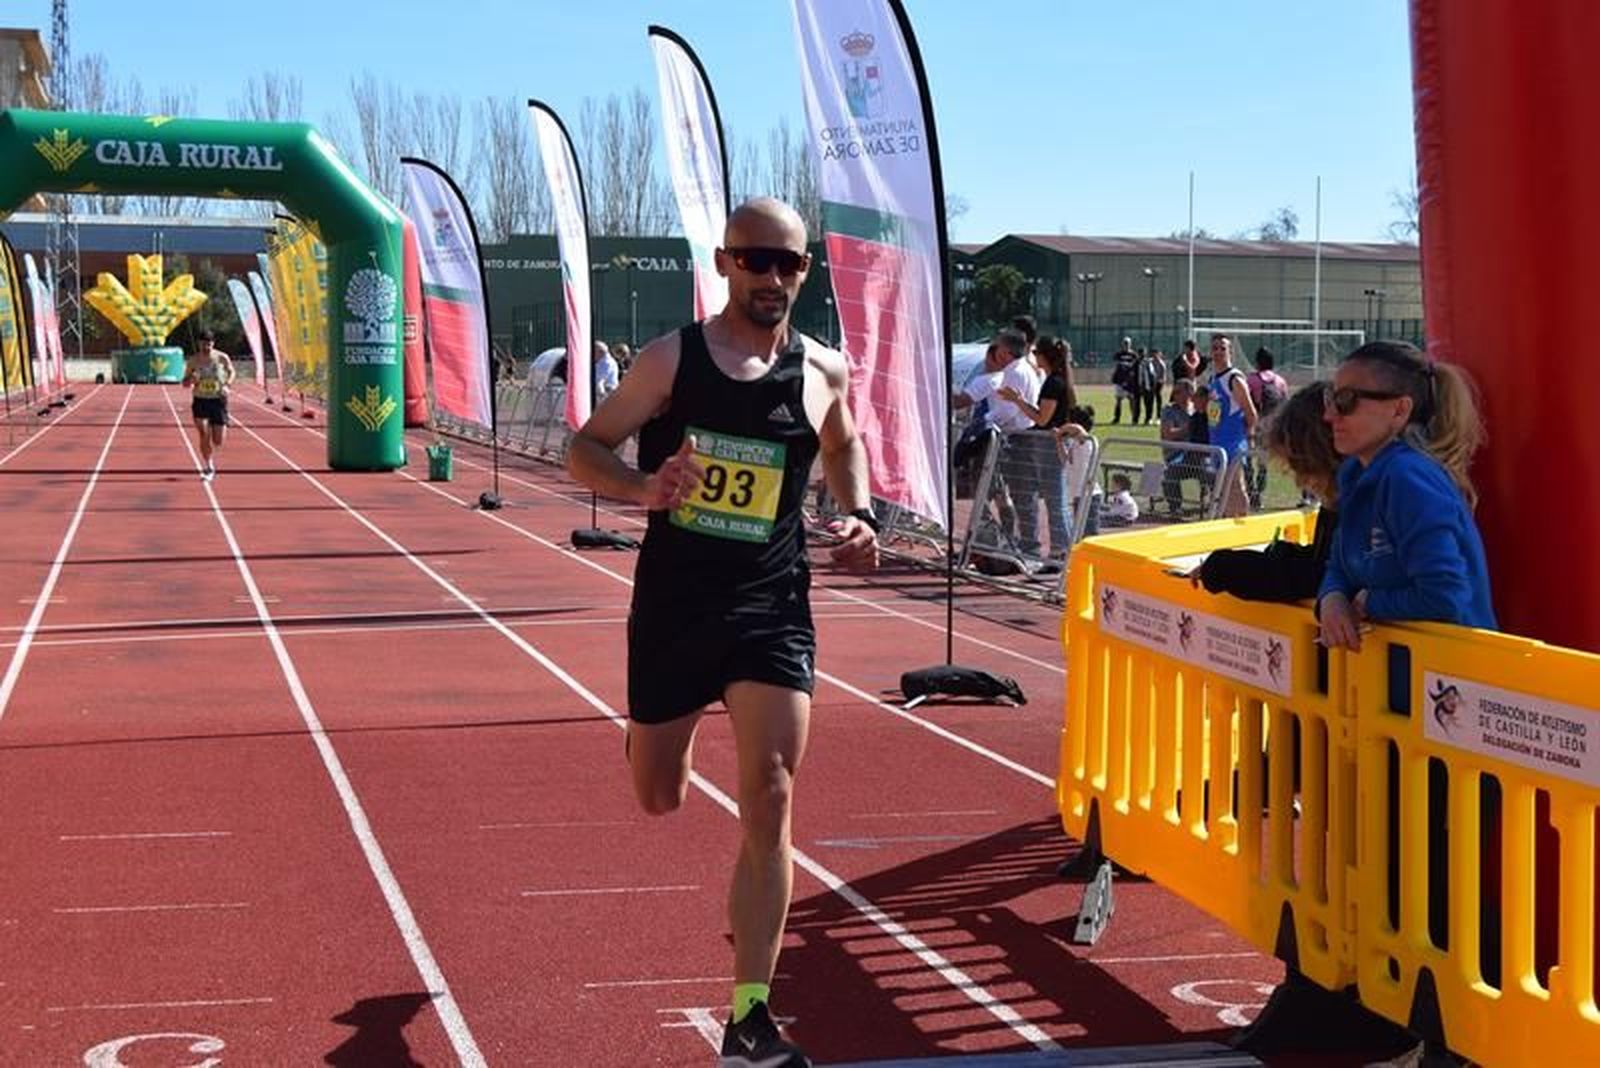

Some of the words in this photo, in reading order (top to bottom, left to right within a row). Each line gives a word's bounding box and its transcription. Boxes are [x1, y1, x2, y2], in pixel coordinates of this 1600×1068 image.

[95, 140, 170, 166] CAJA
[178, 143, 283, 171] RURAL
[637, 257, 678, 271] CAJA
[700, 464, 756, 509] 93
[697, 514, 726, 530] CAJA
[729, 521, 767, 536] RURAL
[1478, 714, 1490, 729] DE
[1495, 719, 1541, 742] CASTILLA
[1547, 731, 1554, 745] Y
[1559, 734, 1587, 753] LEÓN
[1479, 699, 1526, 722] FEDERACIÓN
[1528, 711, 1540, 726] DE
[1541, 714, 1587, 737] ATLETISMO
[1533, 747, 1544, 760] DE
[1545, 751, 1581, 769] ZAMORA
